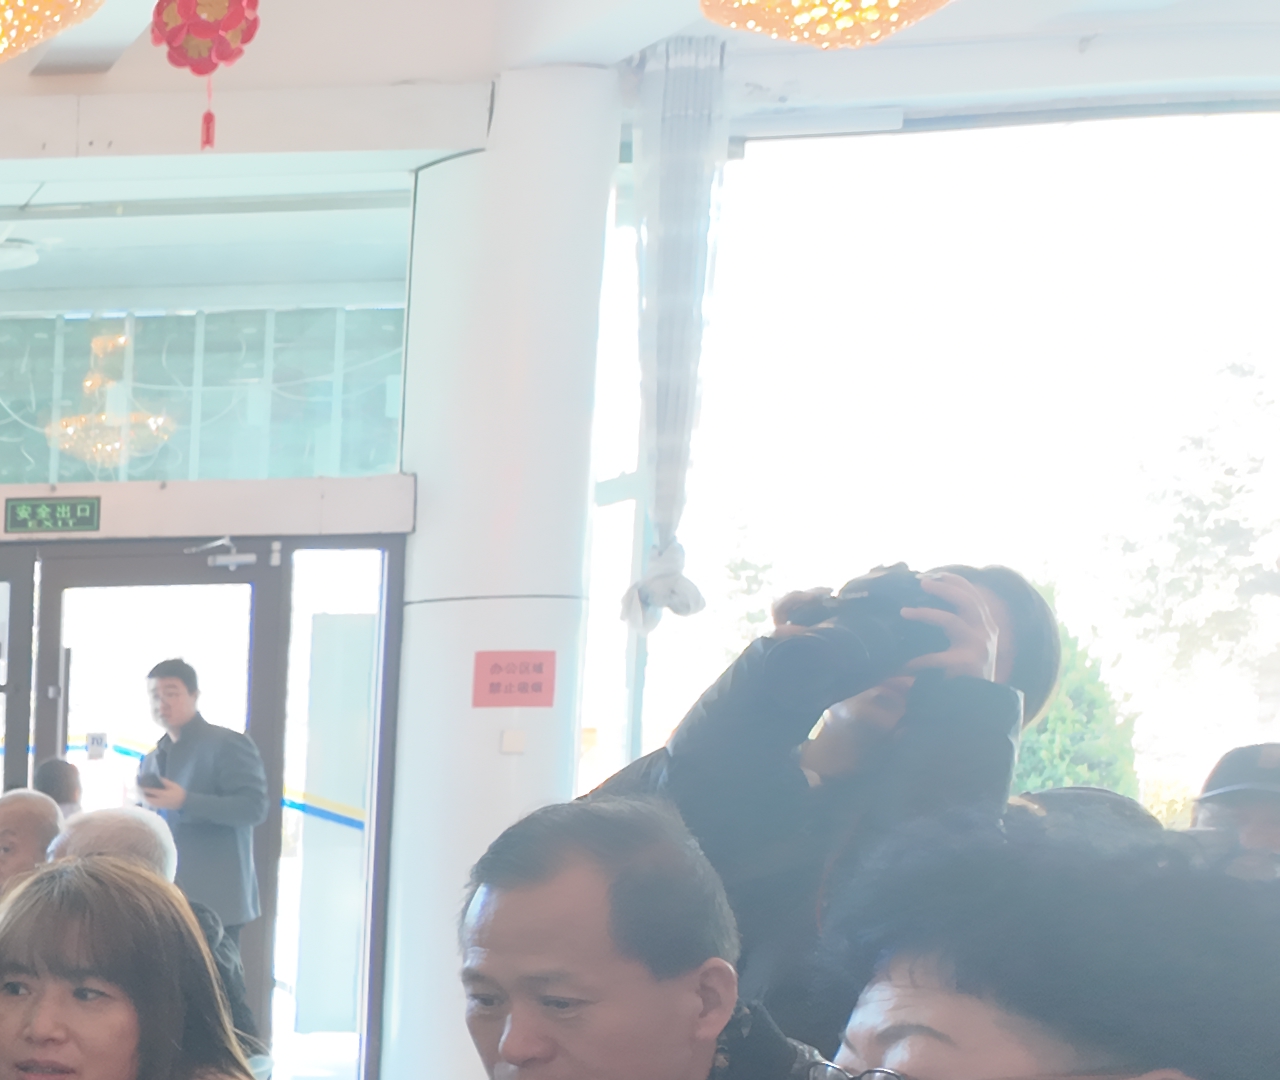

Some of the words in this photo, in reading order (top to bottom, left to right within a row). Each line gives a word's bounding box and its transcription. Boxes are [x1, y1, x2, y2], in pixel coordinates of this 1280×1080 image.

[15, 503, 91, 521] 安全出口
[489, 661, 545, 676] 办公区域
